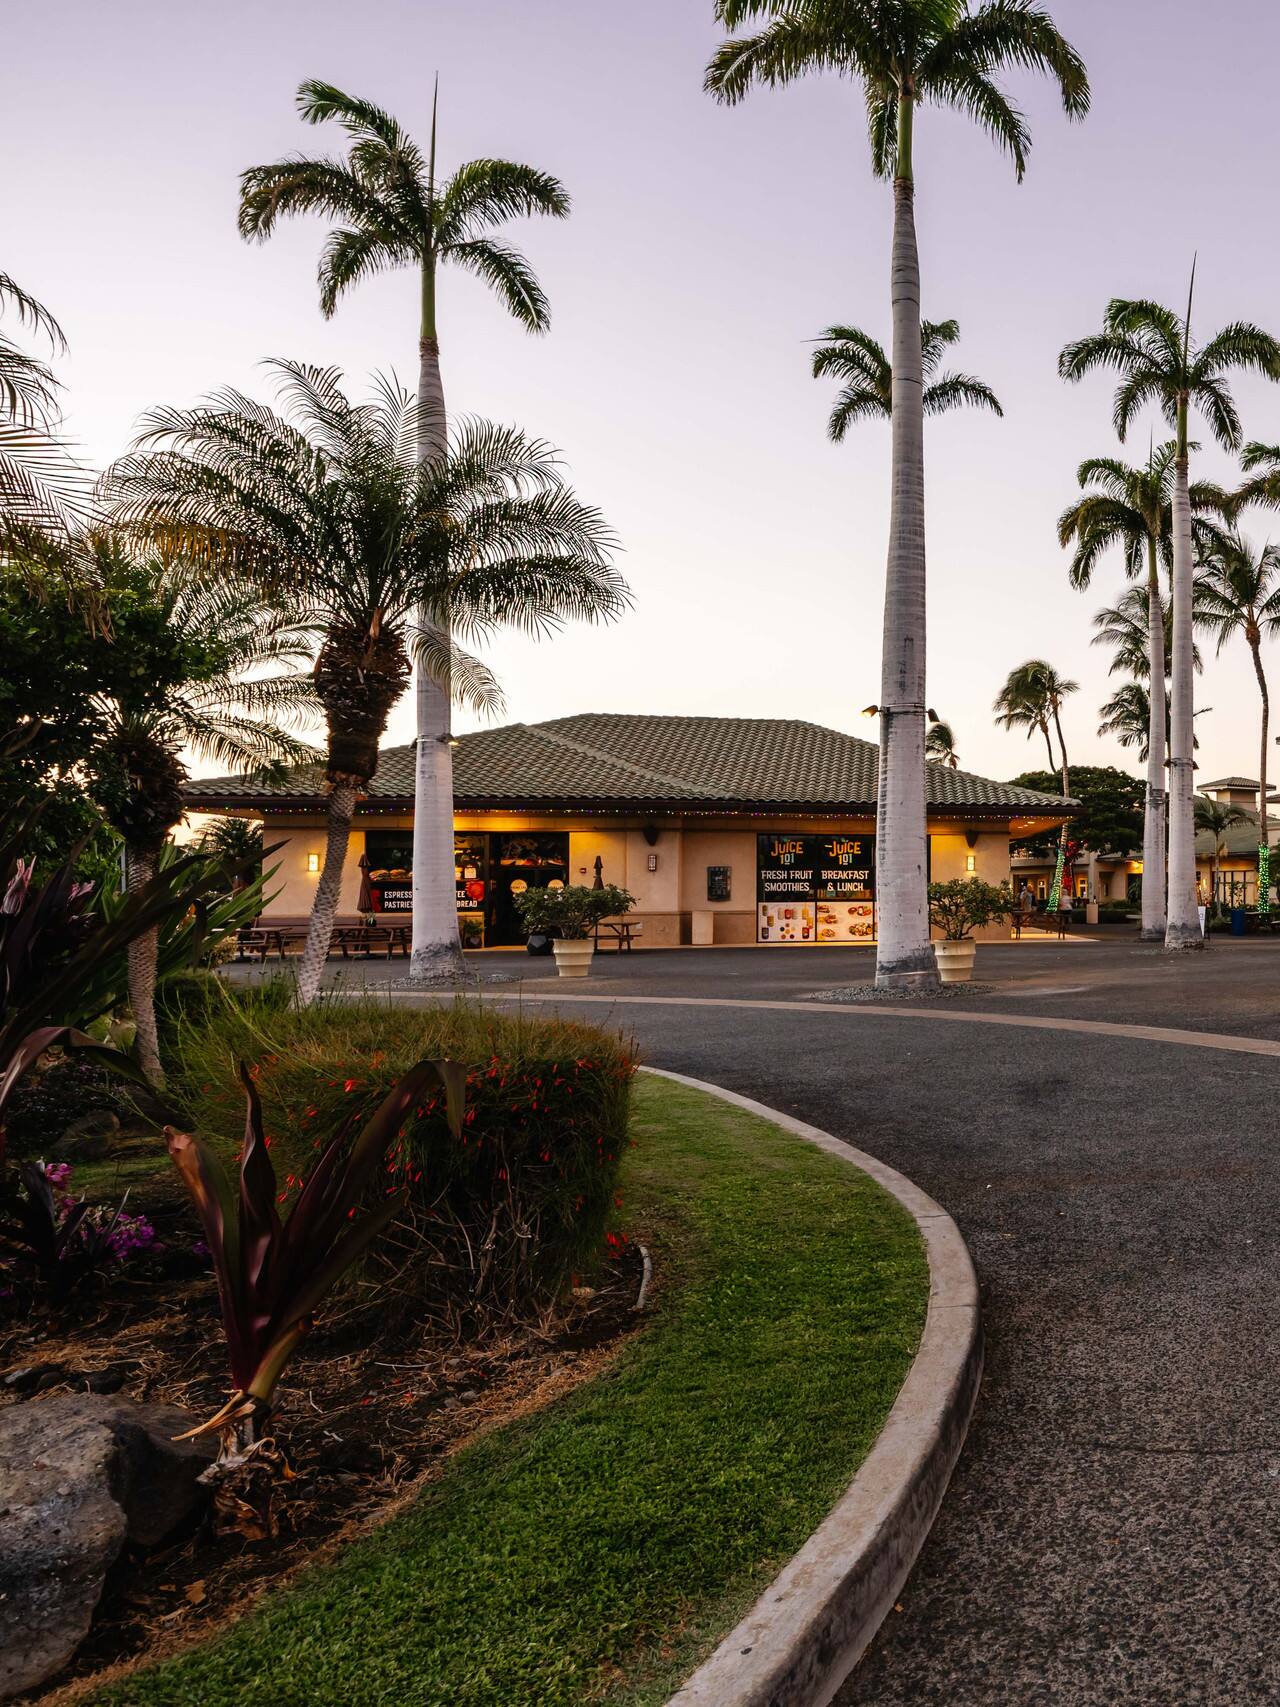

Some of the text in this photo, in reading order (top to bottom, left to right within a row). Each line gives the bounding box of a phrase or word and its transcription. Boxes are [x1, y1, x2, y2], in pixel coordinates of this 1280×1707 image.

[780, 853, 795, 865] 101
[838, 853, 853, 865] 101
[761, 870, 813, 880] FRESH FRUIT
[821, 870, 869, 880] BREAKFAST
[764, 882, 810, 892] SMOOTHIES
[827, 882, 864, 892] & LUNCH
[384, 890, 413, 899] ESPRESS
[456, 900, 478, 908] BREAD
